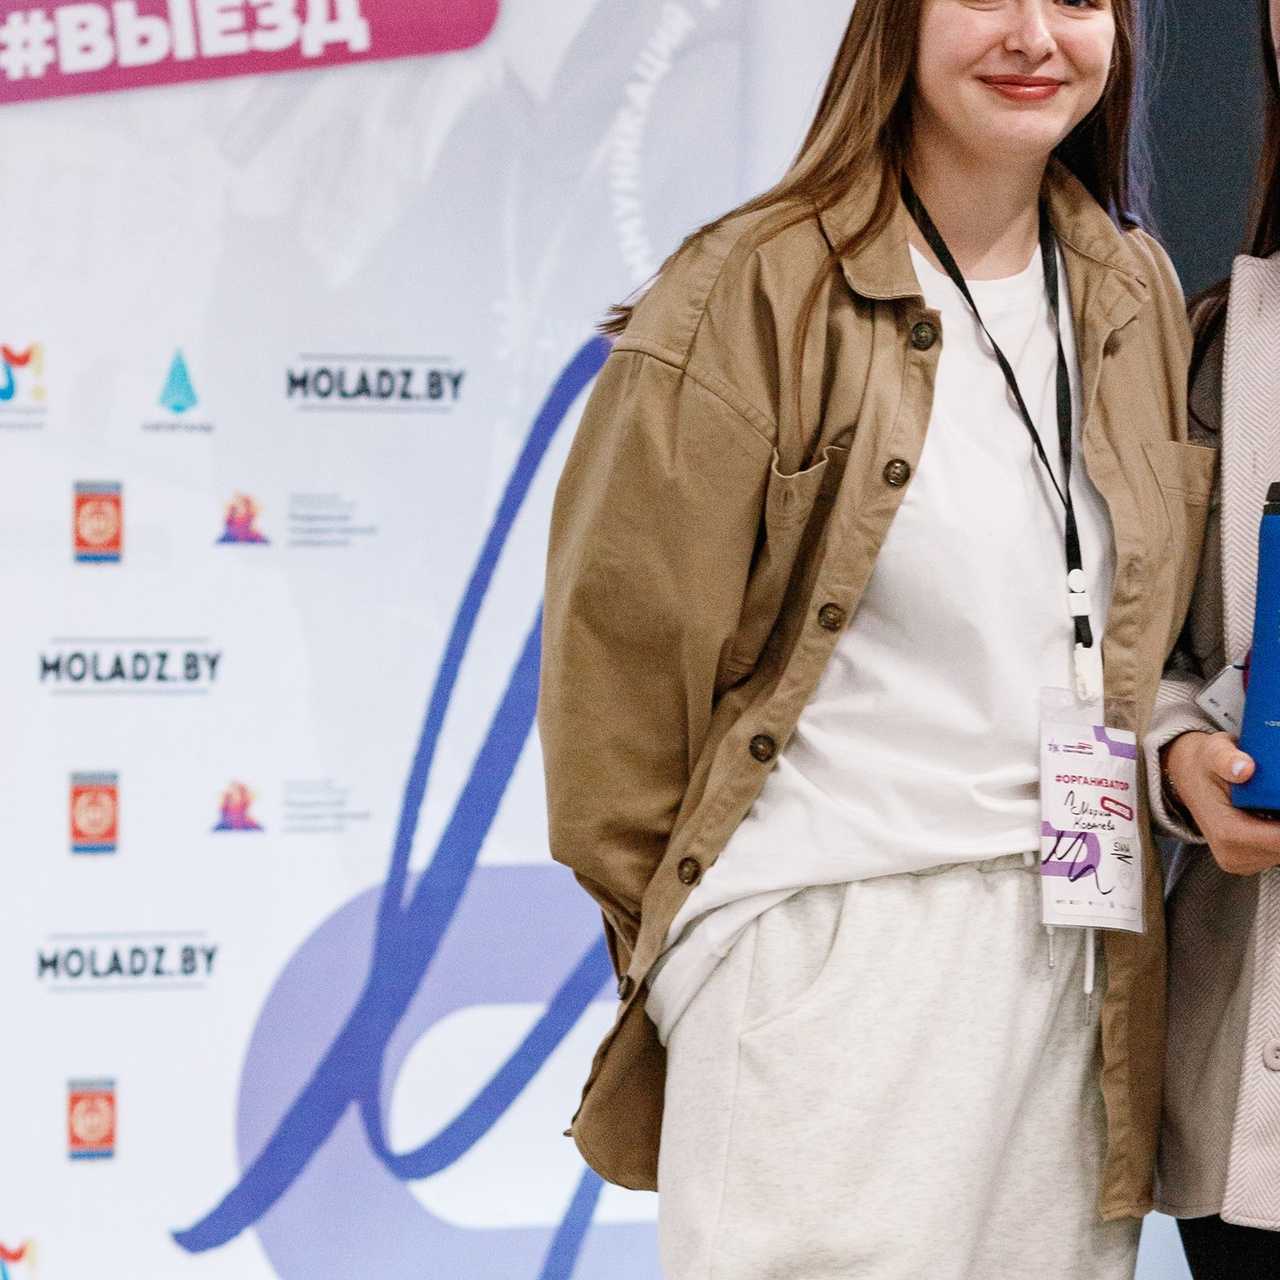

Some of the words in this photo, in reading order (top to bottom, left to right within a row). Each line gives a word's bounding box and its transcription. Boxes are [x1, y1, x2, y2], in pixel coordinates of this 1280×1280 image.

[287, 367, 466, 401] MOLADZ.BY
[39, 650, 221, 683] MOLADZ.BY
[38, 945, 218, 979] MOLADZ.BY
